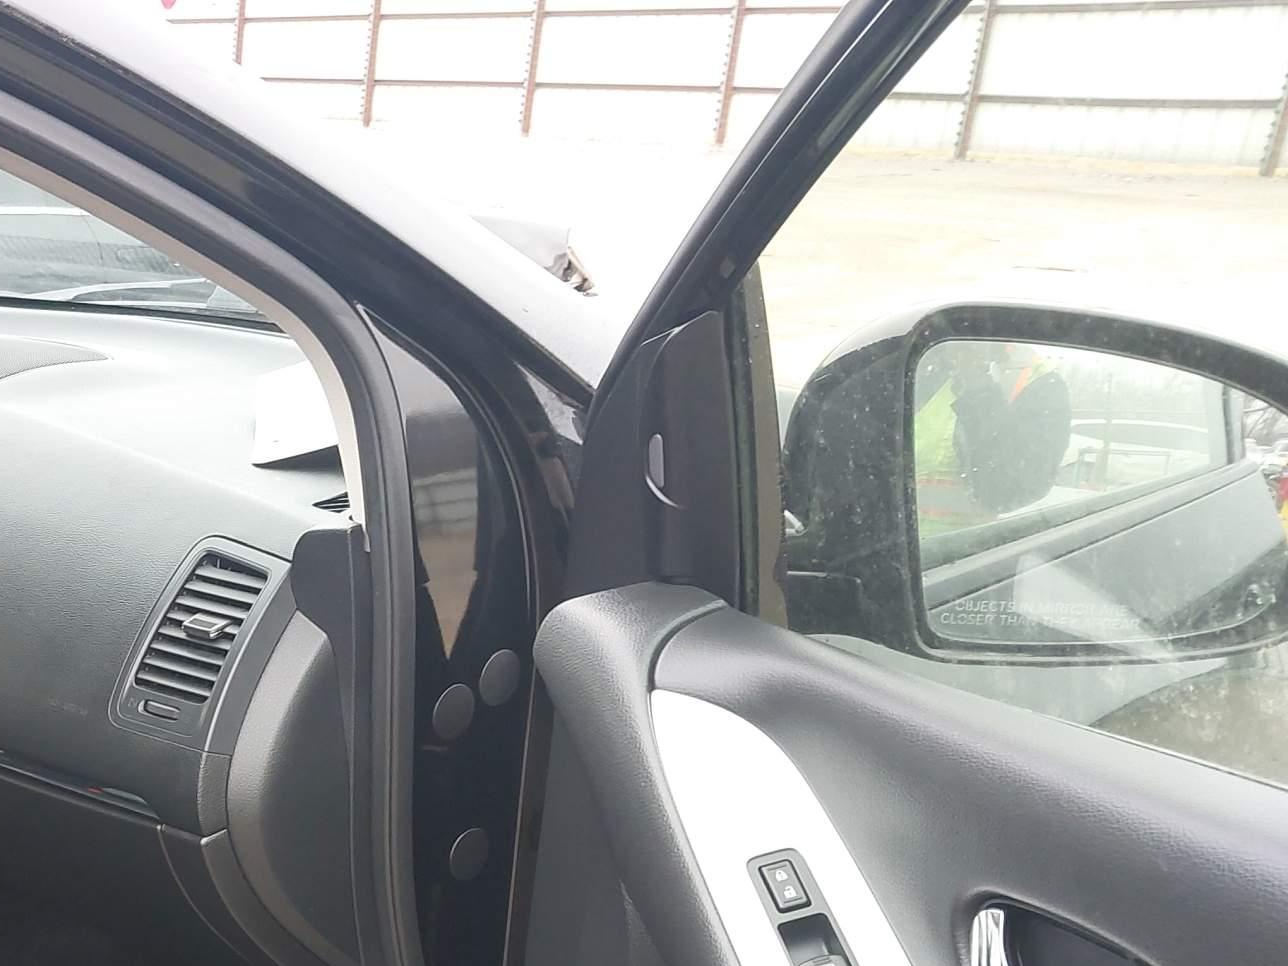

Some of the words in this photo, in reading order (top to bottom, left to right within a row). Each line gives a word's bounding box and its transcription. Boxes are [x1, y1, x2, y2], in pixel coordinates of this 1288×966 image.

[955, 600, 1016, 613] OBJECTS
[1020, 601, 1033, 613] IN
[941, 612, 997, 625] CLOSER
[1042, 615, 1078, 628] THE
[1082, 617, 1141, 630] PEAR
